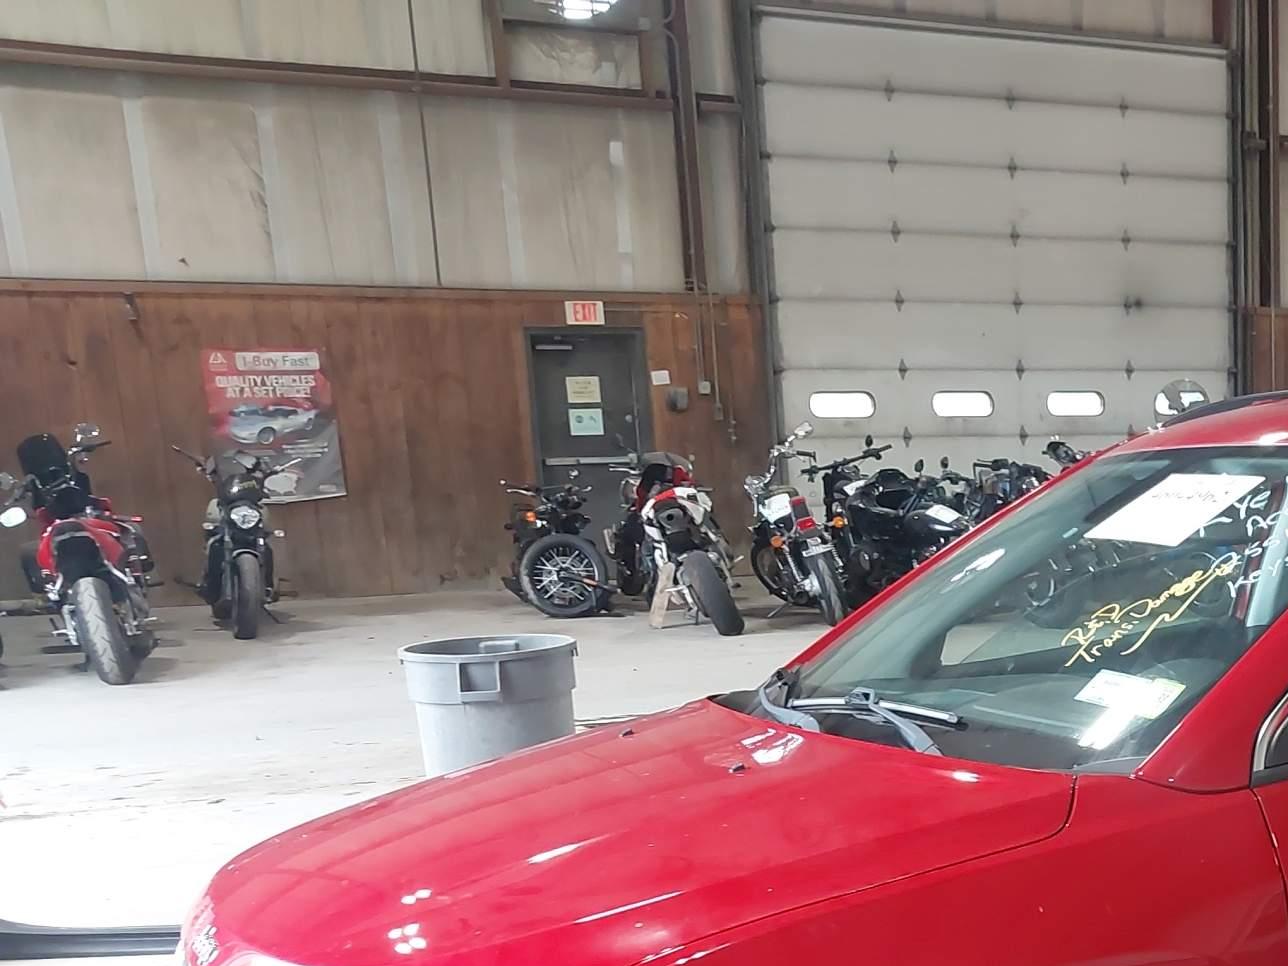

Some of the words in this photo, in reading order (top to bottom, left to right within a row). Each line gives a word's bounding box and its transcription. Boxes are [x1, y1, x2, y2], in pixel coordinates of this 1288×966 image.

[215, 375, 263, 388] QUALITY
[264, 374, 316, 387] VEHICLES
[226, 387, 243, 398] AT
[243, 387, 253, 398] A
[254, 386, 274, 398] SET
